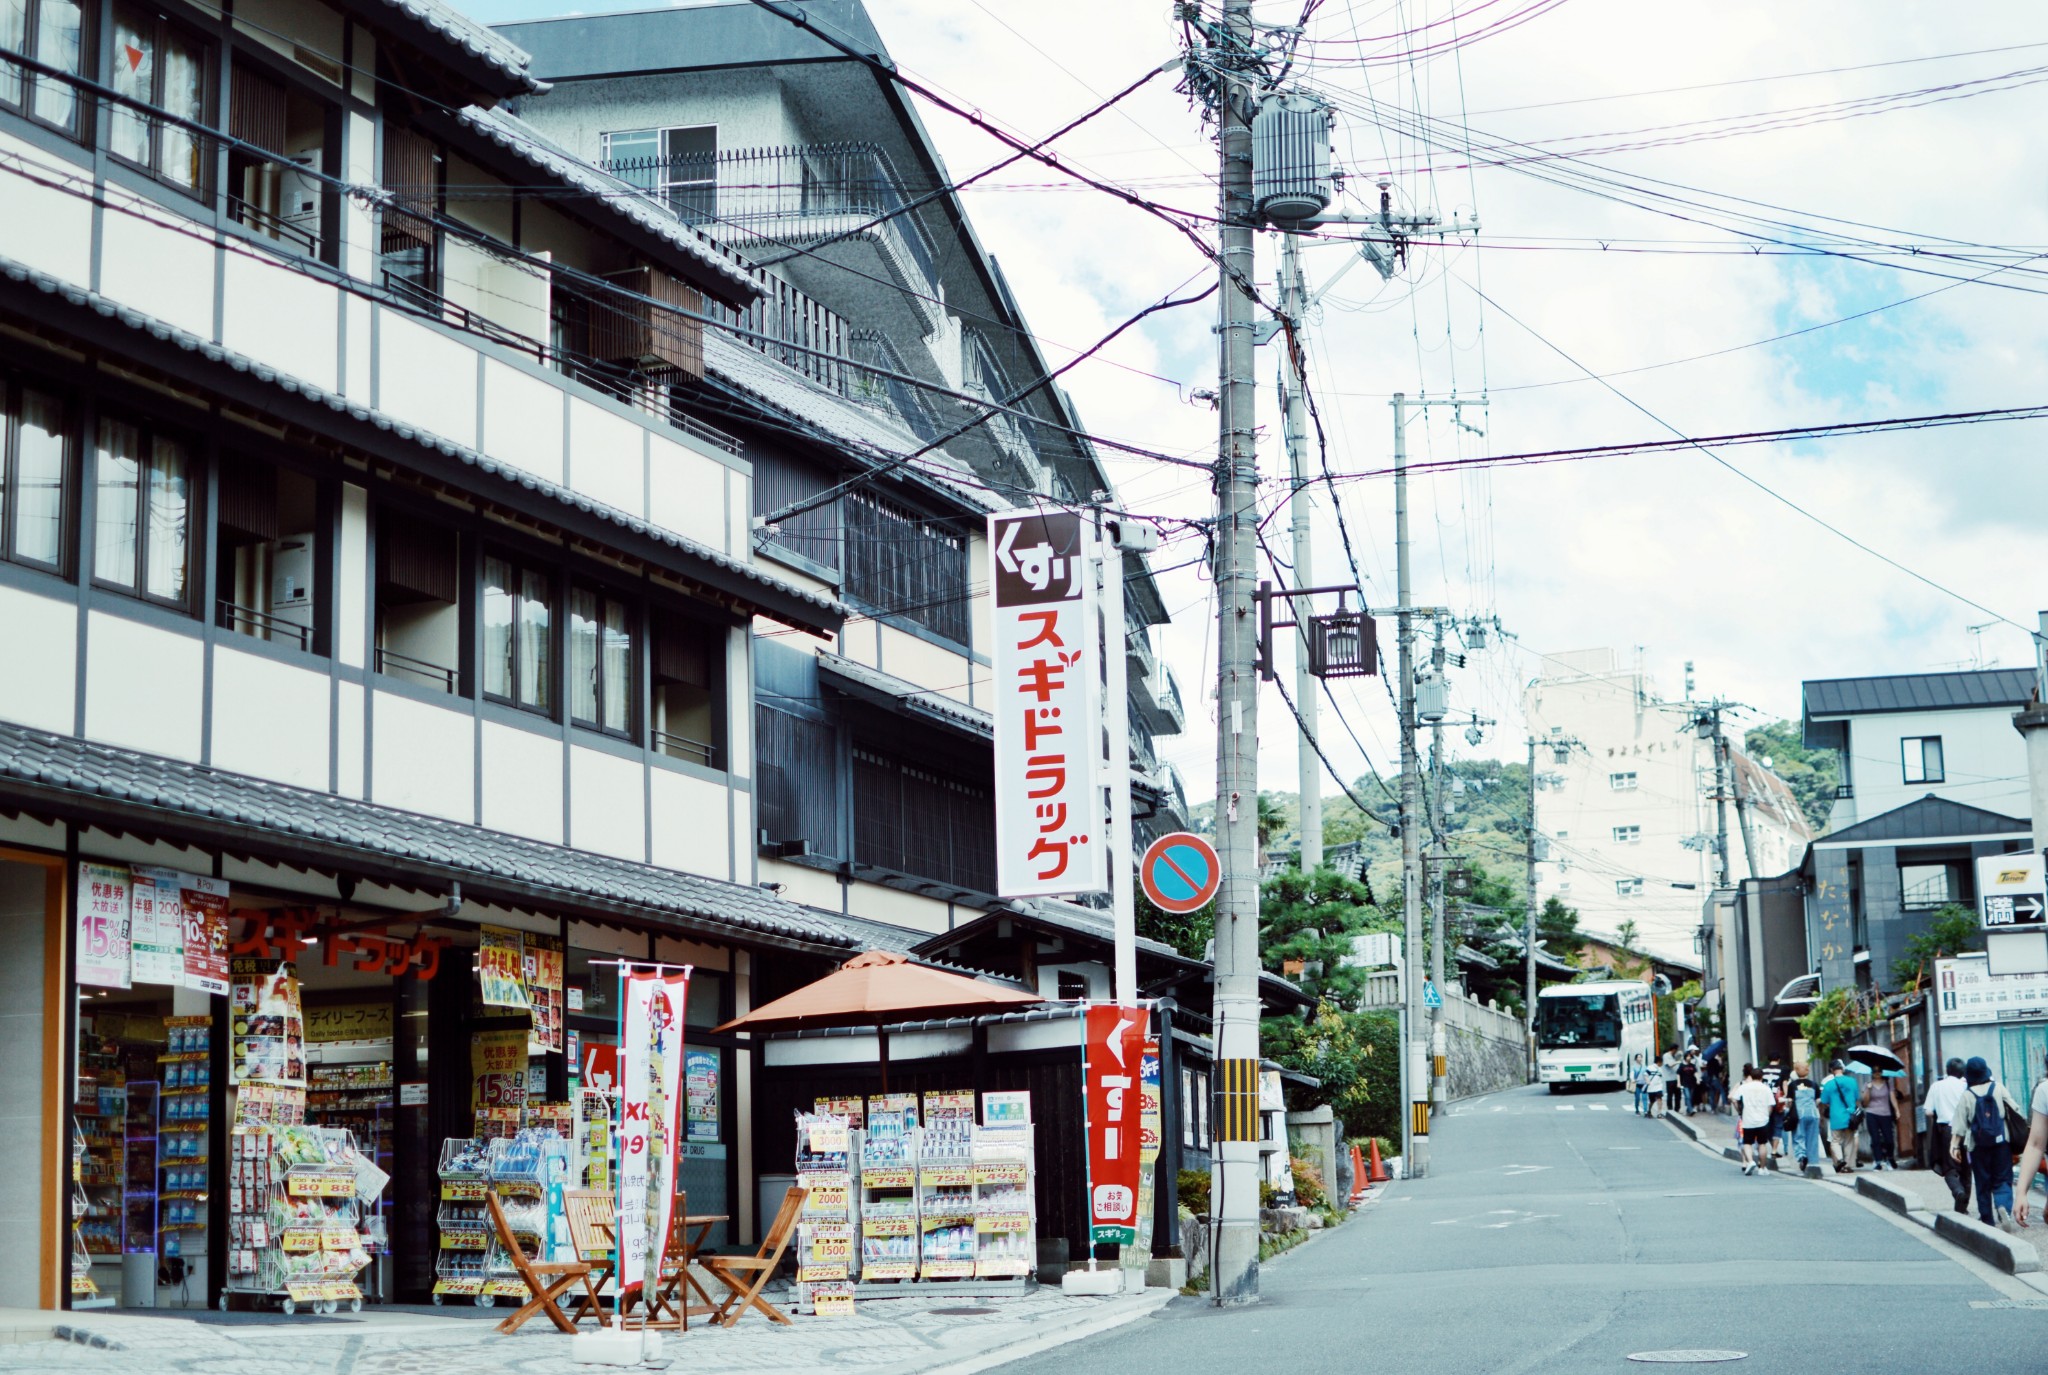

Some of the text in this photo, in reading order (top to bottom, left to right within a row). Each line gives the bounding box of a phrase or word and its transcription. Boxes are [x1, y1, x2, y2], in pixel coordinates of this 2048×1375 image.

[996, 521, 1082, 598] くすり
[1017, 609, 1089, 881] スギドラッグ
[92, 881, 124, 899] 优惠券
[134, 897, 153, 914] 半額
[158, 901, 180, 916] 200
[1986, 896, 2015, 924] 満
[1818, 880, 1844, 961] たなか
[109, 939, 131, 960] OFF
[228, 908, 452, 980] スギドラッグ
[232, 958, 256, 973] 免税
[309, 1007, 390, 1026] デイリーフーズ
[484, 1046, 518, 1059] 优惠券
[1140, 1060, 1160, 1078] OFF
[502, 1089, 526, 1102] OFF
[690, 1145, 705, 1155] DRUG
[818, 1194, 842, 1204] 2000
[821, 1246, 846, 1255] 1500
